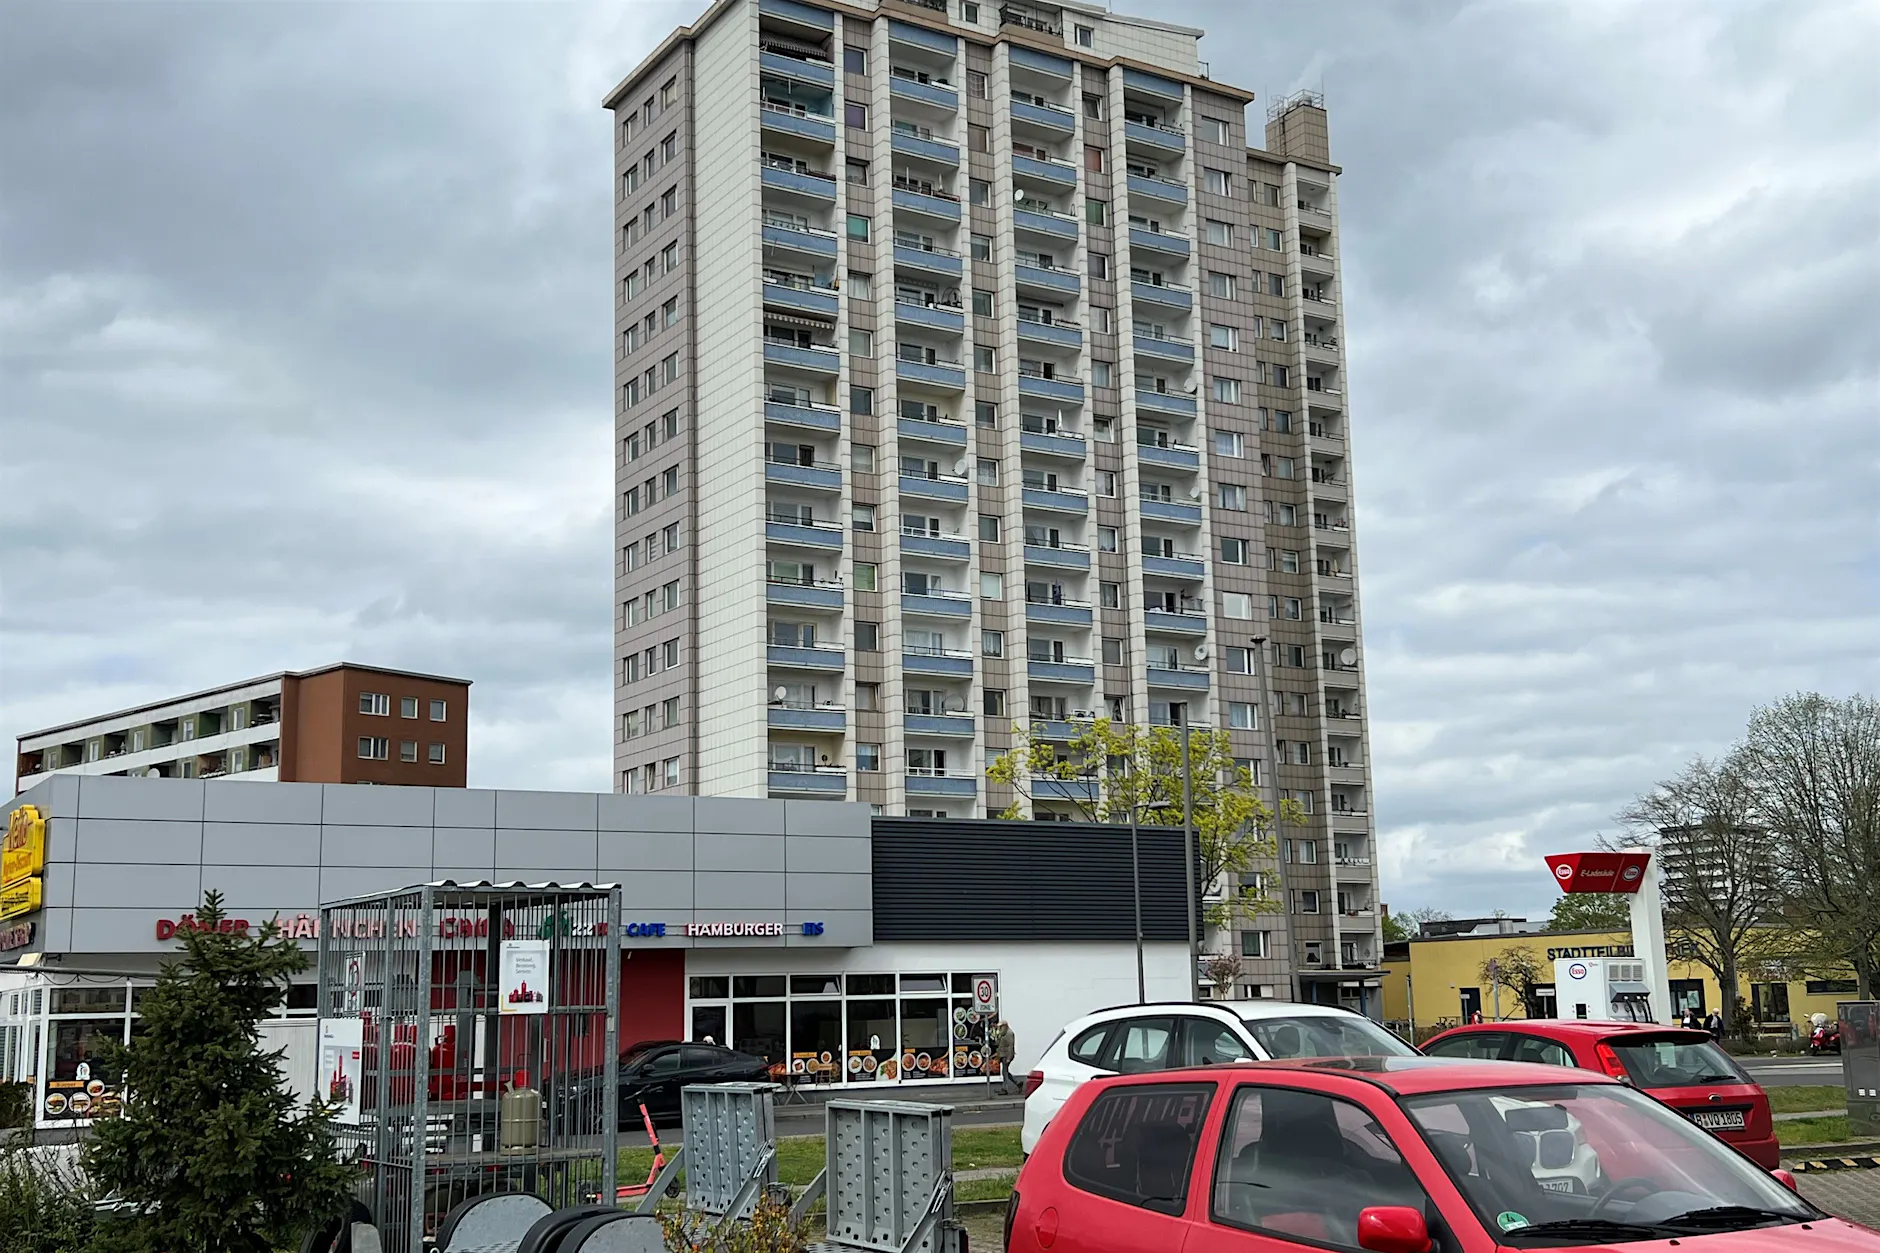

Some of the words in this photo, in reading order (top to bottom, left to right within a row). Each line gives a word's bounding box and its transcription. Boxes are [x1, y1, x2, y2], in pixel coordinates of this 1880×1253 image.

[626, 922, 666, 938] CAFE
[684, 922, 784, 938] HAMBURGER
[802, 921, 824, 936] EIS
[1571, 967, 1585, 975] Esso
[979, 986, 989, 998] 30
[1695, 1113, 1703, 1126] B
[1505, 1213, 1516, 1223] 4
